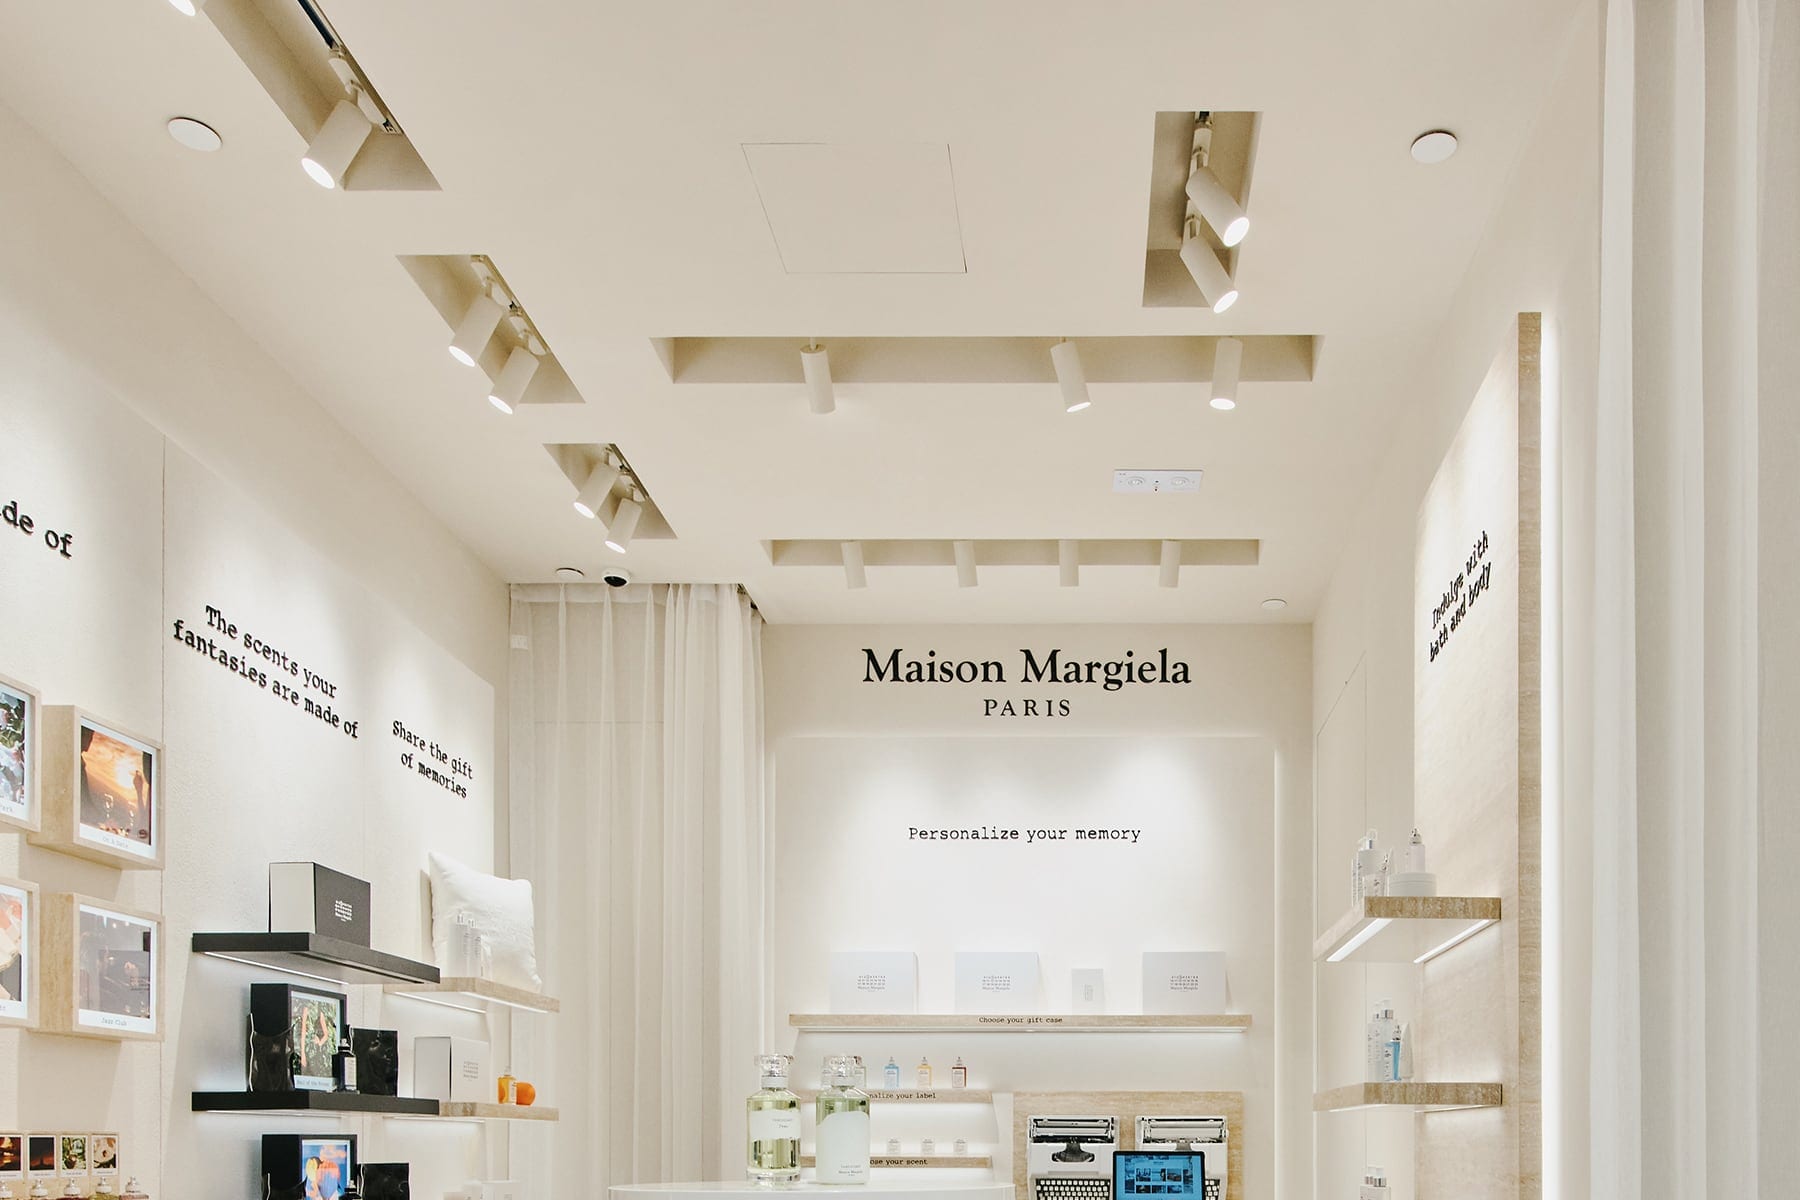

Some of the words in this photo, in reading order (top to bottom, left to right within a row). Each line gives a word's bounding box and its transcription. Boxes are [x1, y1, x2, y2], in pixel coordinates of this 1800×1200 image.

[0, 500, 34, 535] de
[45, 530, 72, 560] of
[1432, 572, 1464, 630] Indulge
[1466, 530, 1489, 577] with
[1430, 623, 1449, 663] bath
[1450, 593, 1467, 633] and
[1468, 561, 1492, 608] body
[206, 605, 239, 639] The
[243, 633, 299, 676] scents
[303, 668, 338, 699] your
[861, 648, 1006, 684] Maison
[1019, 647, 1191, 692] Margiela
[173, 619, 268, 690] fantasies
[272, 680, 300, 706] are
[304, 697, 341, 728] made
[343, 720, 359, 739] of
[983, 699, 1071, 717] PARIS
[392, 720, 427, 752] Share
[429, 741, 449, 765] the
[451, 757, 474, 780] gift
[400, 752, 414, 770] of
[418, 761, 468, 799] memories
[908, 826, 1019, 840] Personalize
[1026, 828, 1067, 844] your
[1075, 828, 1142, 844] memory
[978, 1016, 1005, 1024] Choose
[1006, 1017, 1024, 1025] your
[869, 1092, 894, 1100] nalize
